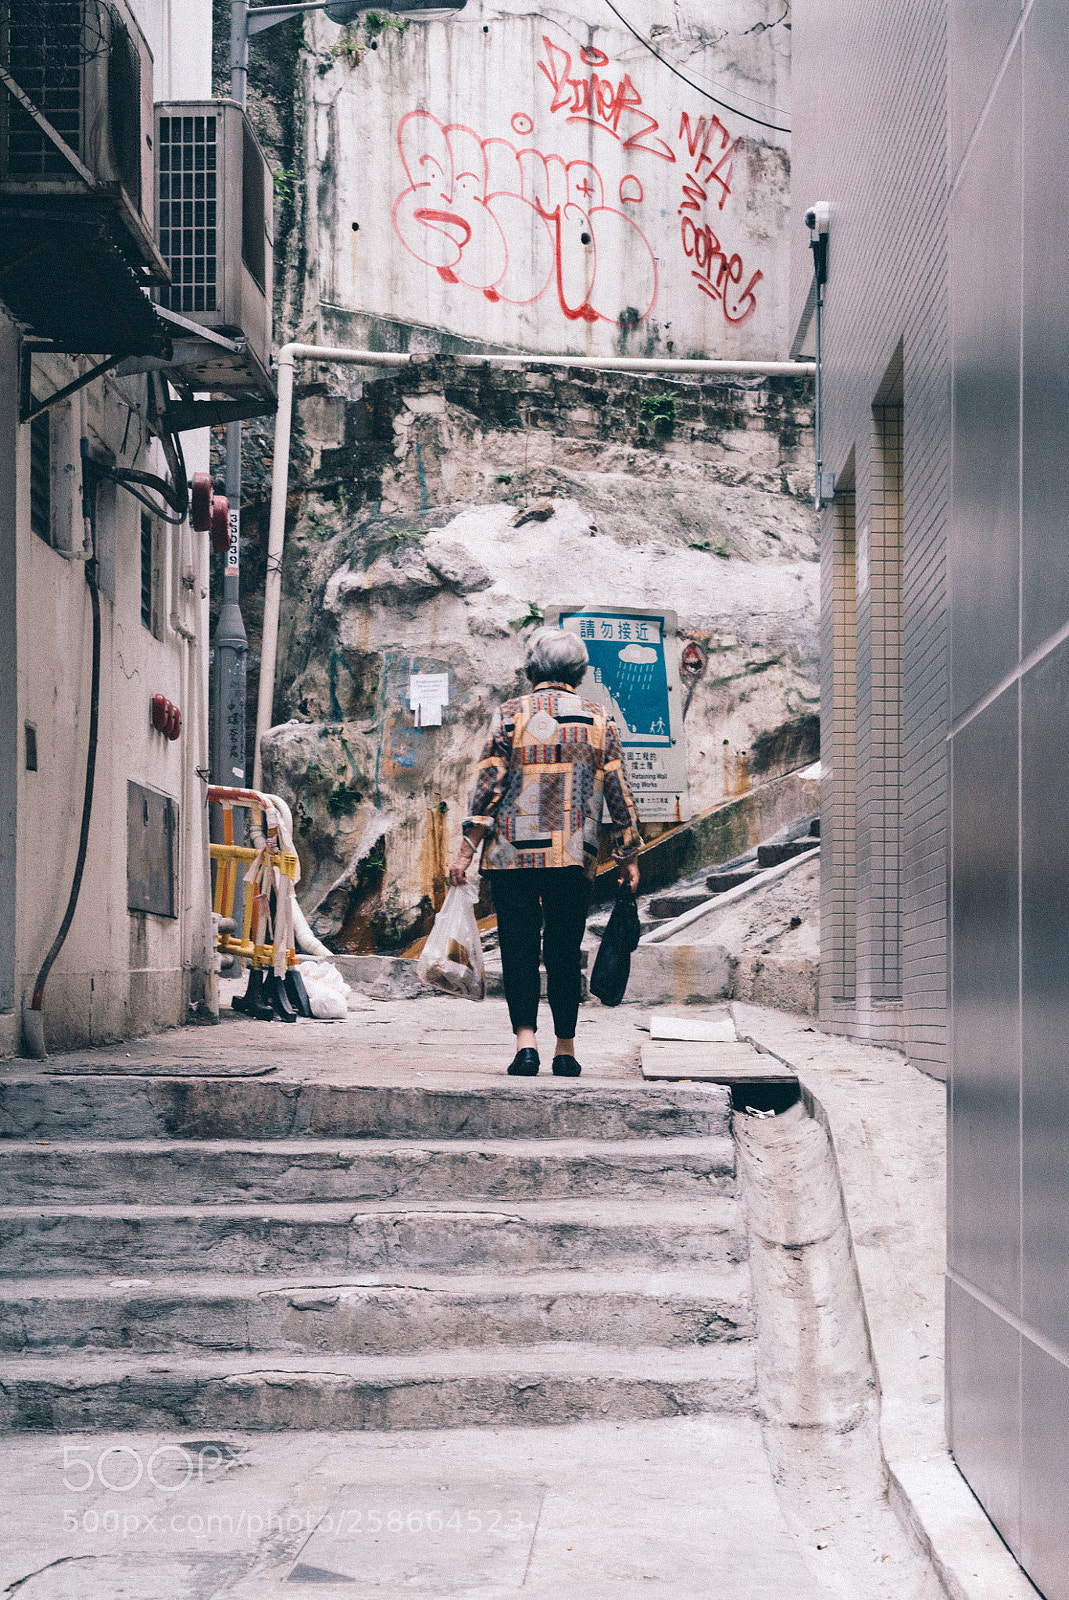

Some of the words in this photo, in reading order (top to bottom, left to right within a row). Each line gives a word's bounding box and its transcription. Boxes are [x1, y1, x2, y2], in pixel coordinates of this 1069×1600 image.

[579, 618, 649, 642] 請勿接近
[631, 773, 656, 781] Retaining
